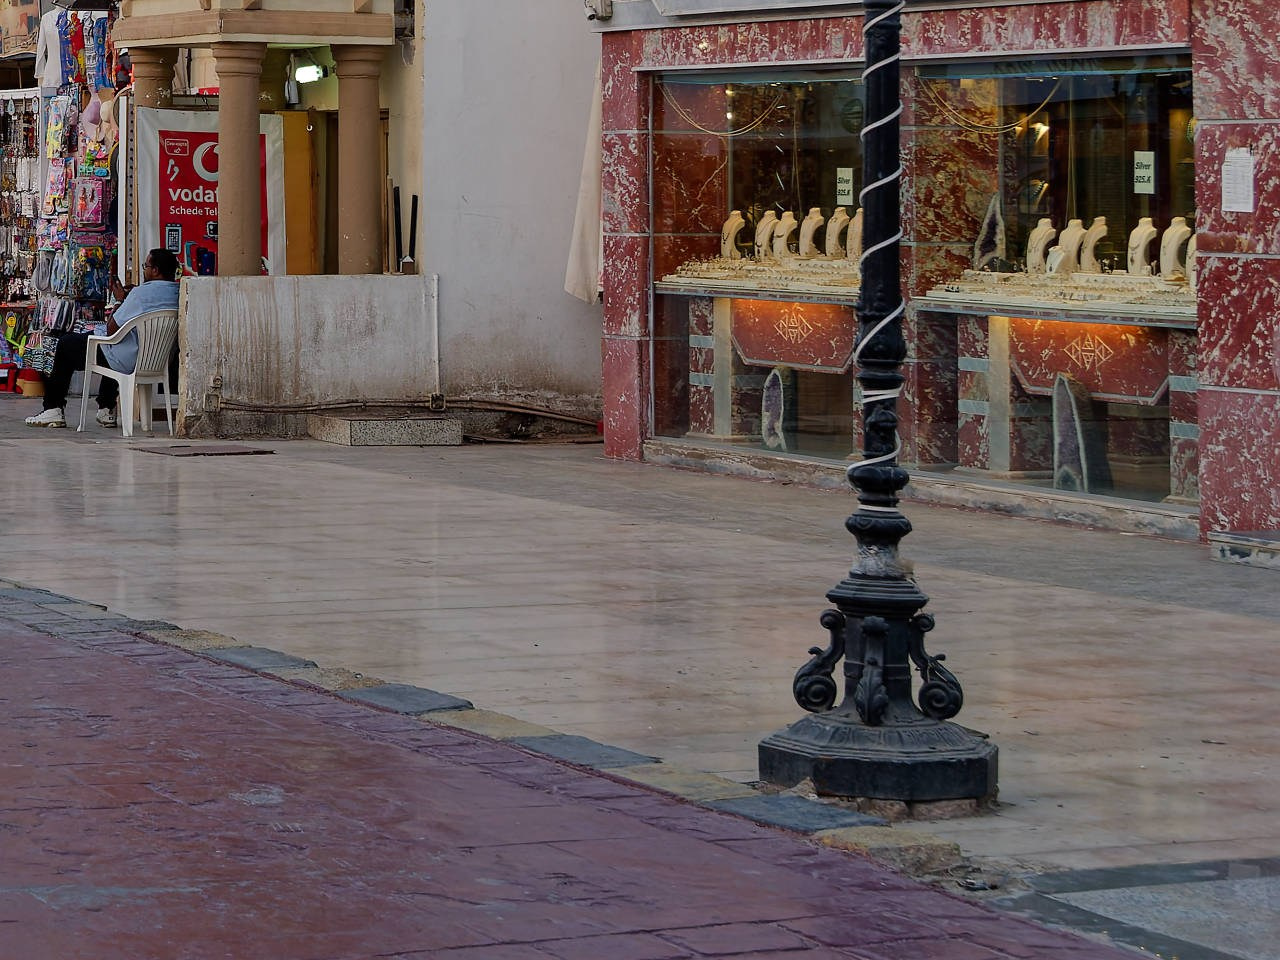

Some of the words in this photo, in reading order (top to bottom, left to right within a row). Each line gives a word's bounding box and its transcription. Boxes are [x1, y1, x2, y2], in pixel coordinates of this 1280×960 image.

[168, 185, 218, 203] vodaf
[169, 205, 203, 216] Schede
[204, 206, 218, 216] Tel
